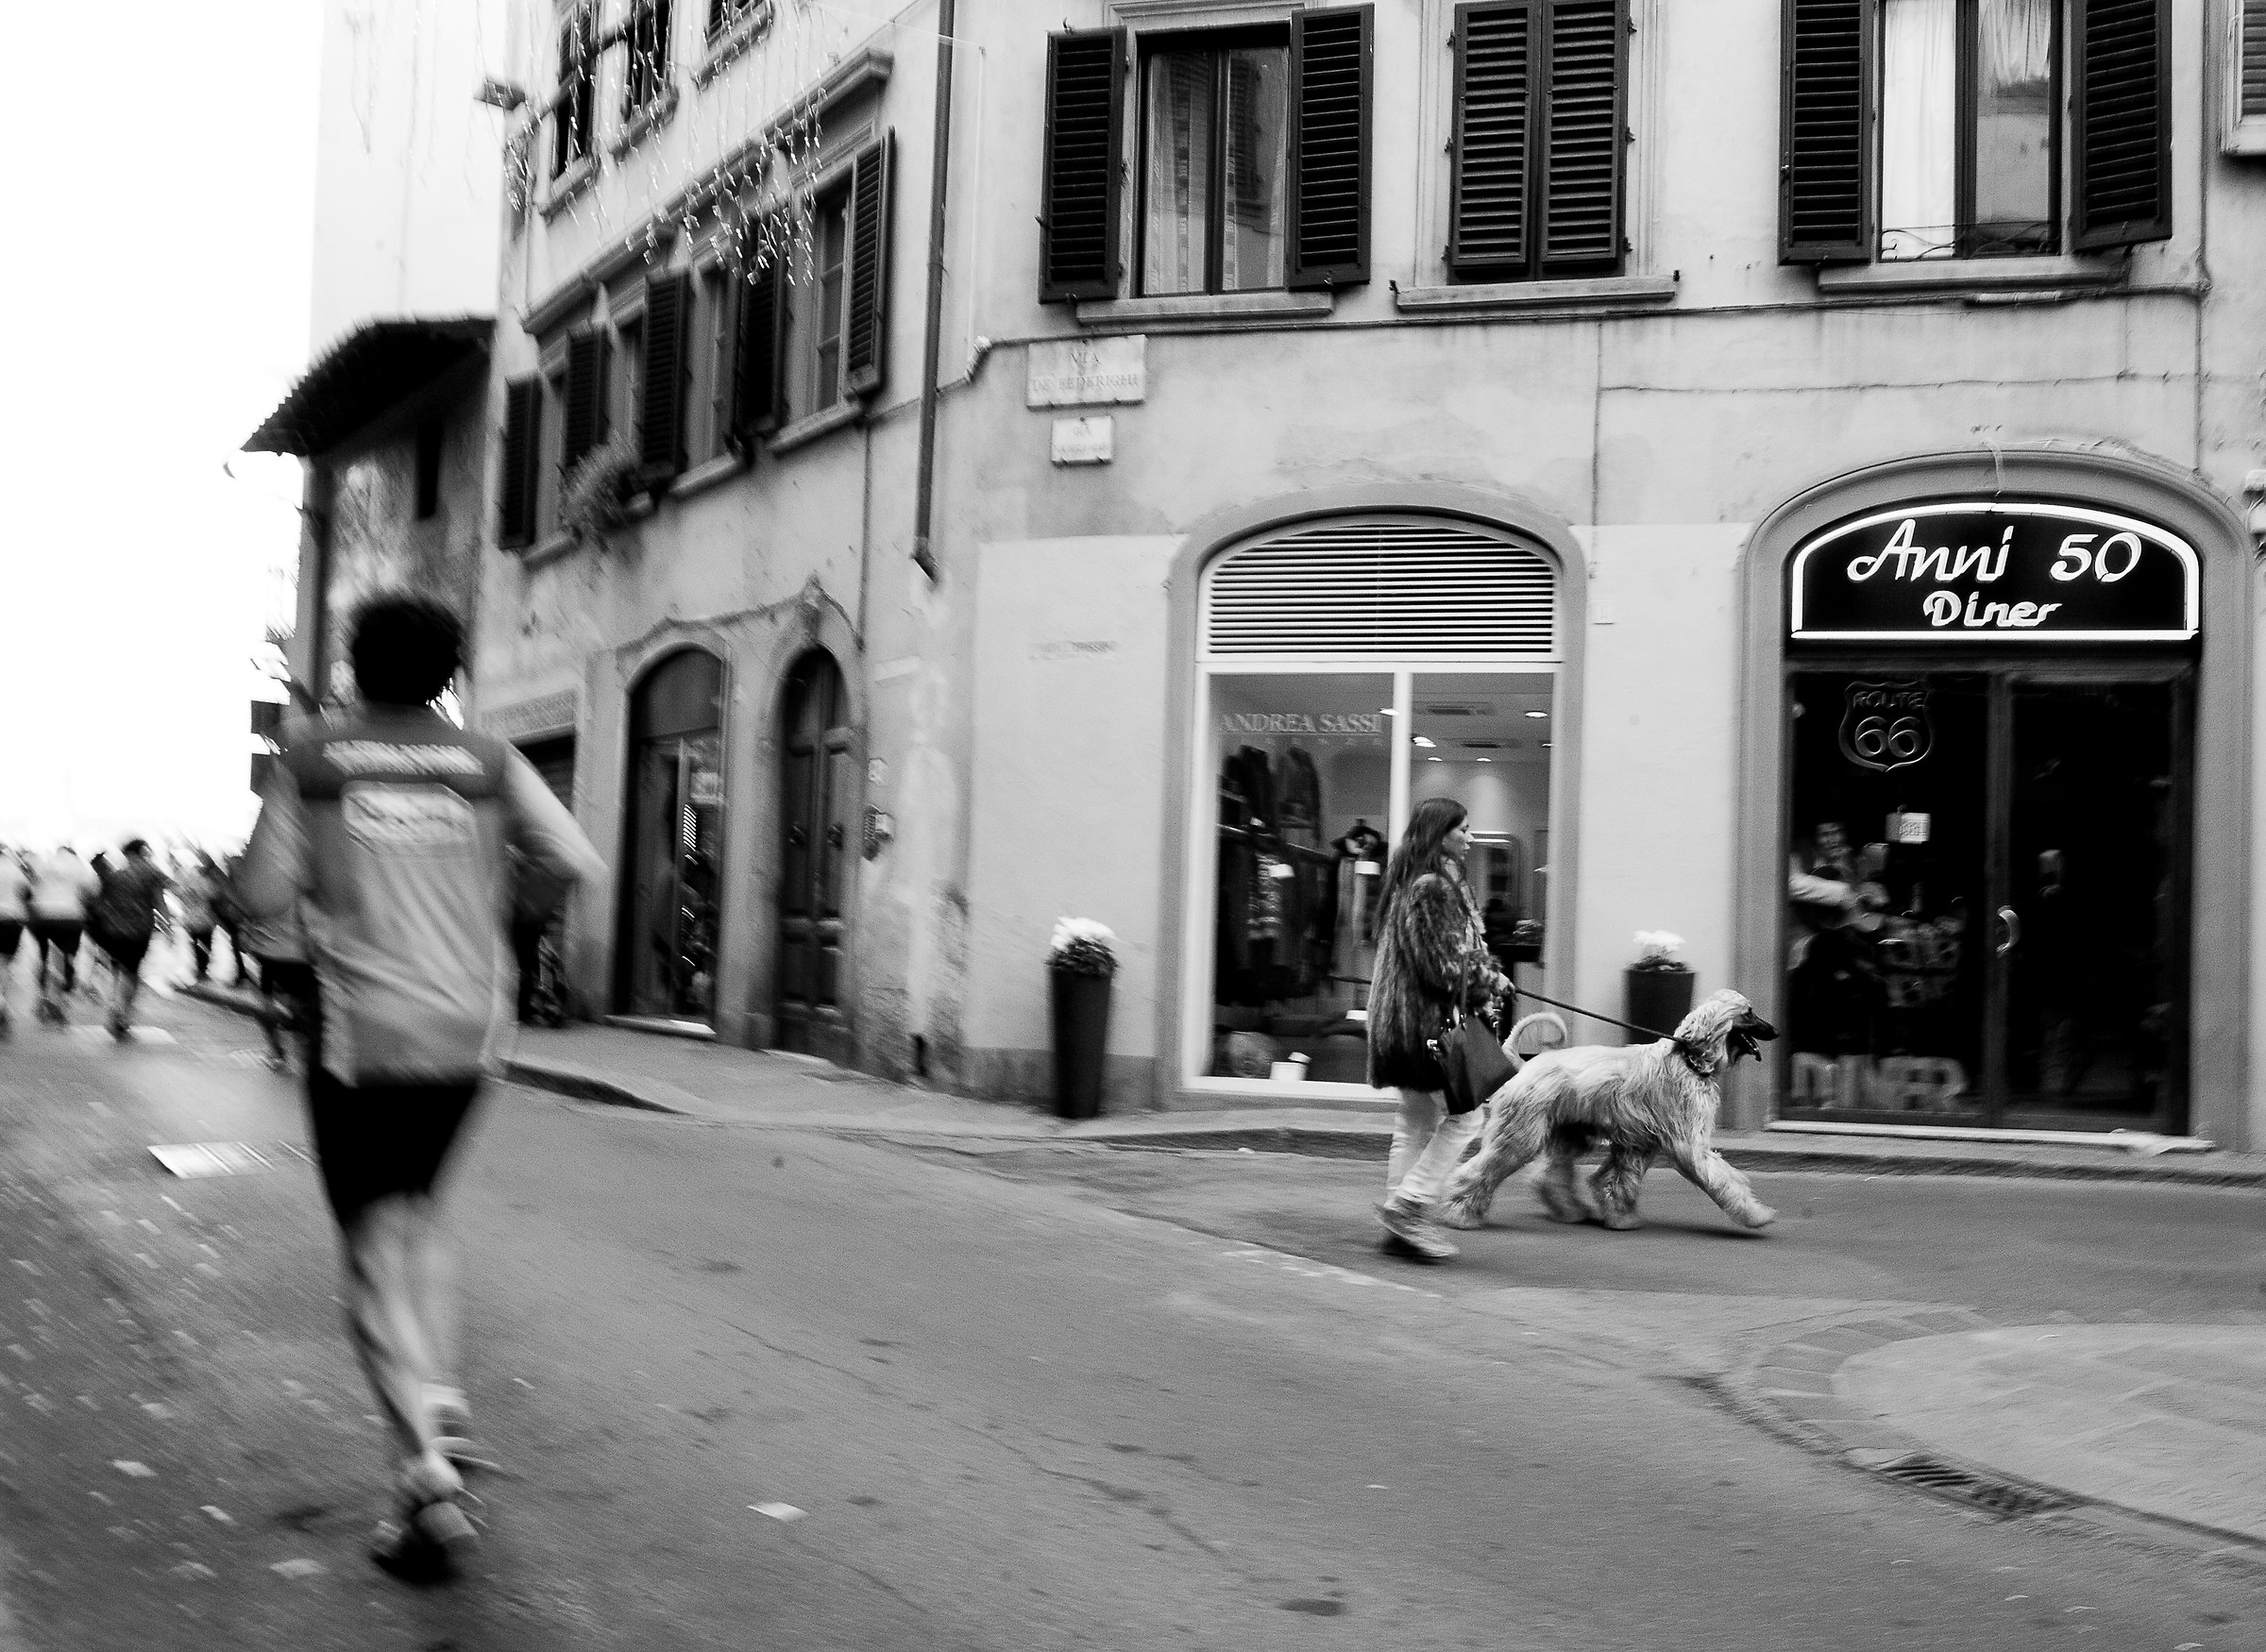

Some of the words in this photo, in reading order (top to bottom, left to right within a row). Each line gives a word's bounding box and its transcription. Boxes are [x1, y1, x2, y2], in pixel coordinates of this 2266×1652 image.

[1847, 518, 2014, 582] Anni
[2050, 531, 2143, 583] 50
[1922, 590, 2063, 628] Diner
[1852, 690, 1925, 709] ROUTE
[1221, 713, 1316, 733] ANDREA
[1319, 713, 1383, 733] SASSI
[1854, 716, 1922, 758] 66
